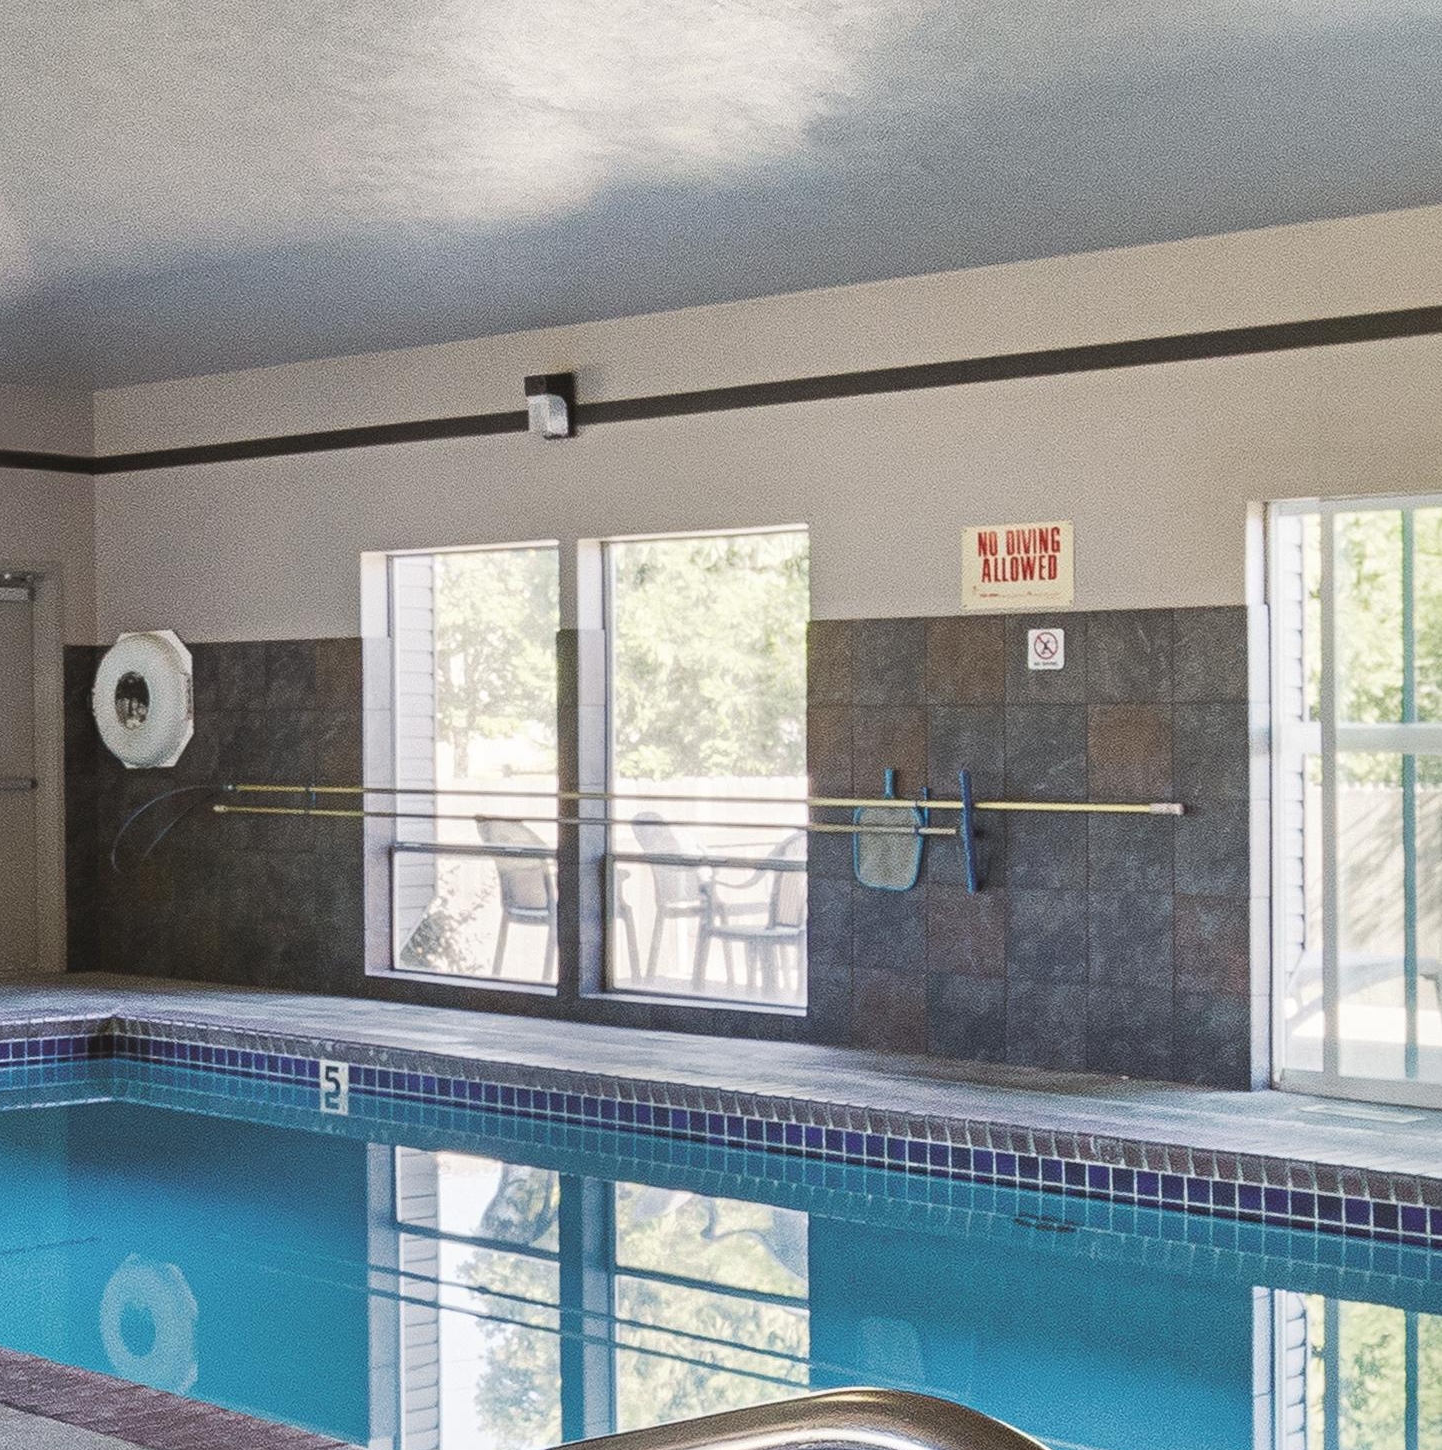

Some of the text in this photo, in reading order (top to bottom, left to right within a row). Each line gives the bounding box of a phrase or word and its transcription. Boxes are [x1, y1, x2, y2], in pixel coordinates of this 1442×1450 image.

[977, 526, 1061, 557] NO DIVING
[981, 554, 1058, 583] ALLOWED
[324, 1065, 341, 1094] 5
